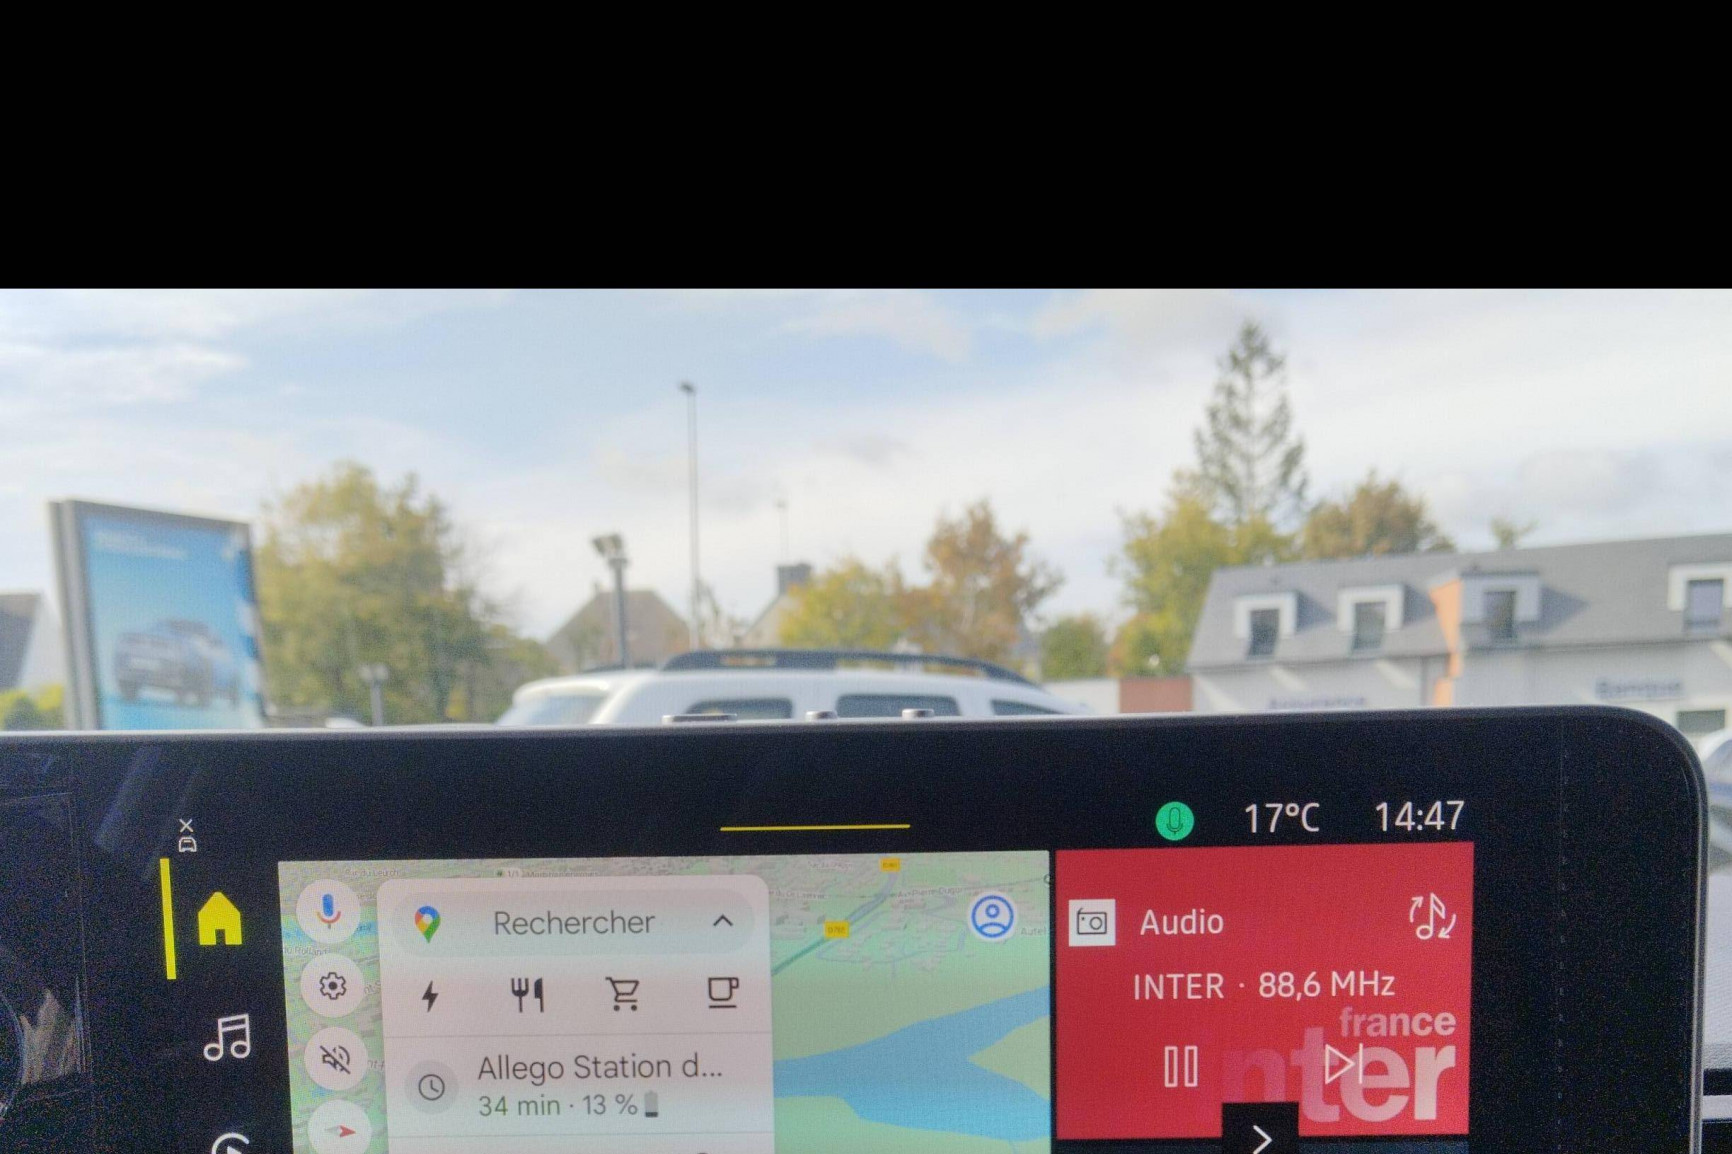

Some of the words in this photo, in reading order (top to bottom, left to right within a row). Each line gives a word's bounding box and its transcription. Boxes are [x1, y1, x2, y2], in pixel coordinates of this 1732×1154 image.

[1245, 803, 1320, 833] 17°C
[1375, 801, 1465, 832] 14:47
[494, 909, 656, 936] Rechercher
[1140, 908, 1224, 936] Audio
[1134, 972, 1225, 1000] INTER
[1258, 971, 1322, 1001] 88,6
[1330, 969, 1396, 998] MHz
[1339, 1006, 1457, 1038] france
[478, 1053, 565, 1086] Allego
[573, 1052, 672, 1080] Station
[478, 1094, 509, 1117] 34
[517, 1093, 561, 1116] min
[583, 1093, 607, 1116] 13
[614, 1093, 638, 1116] %
